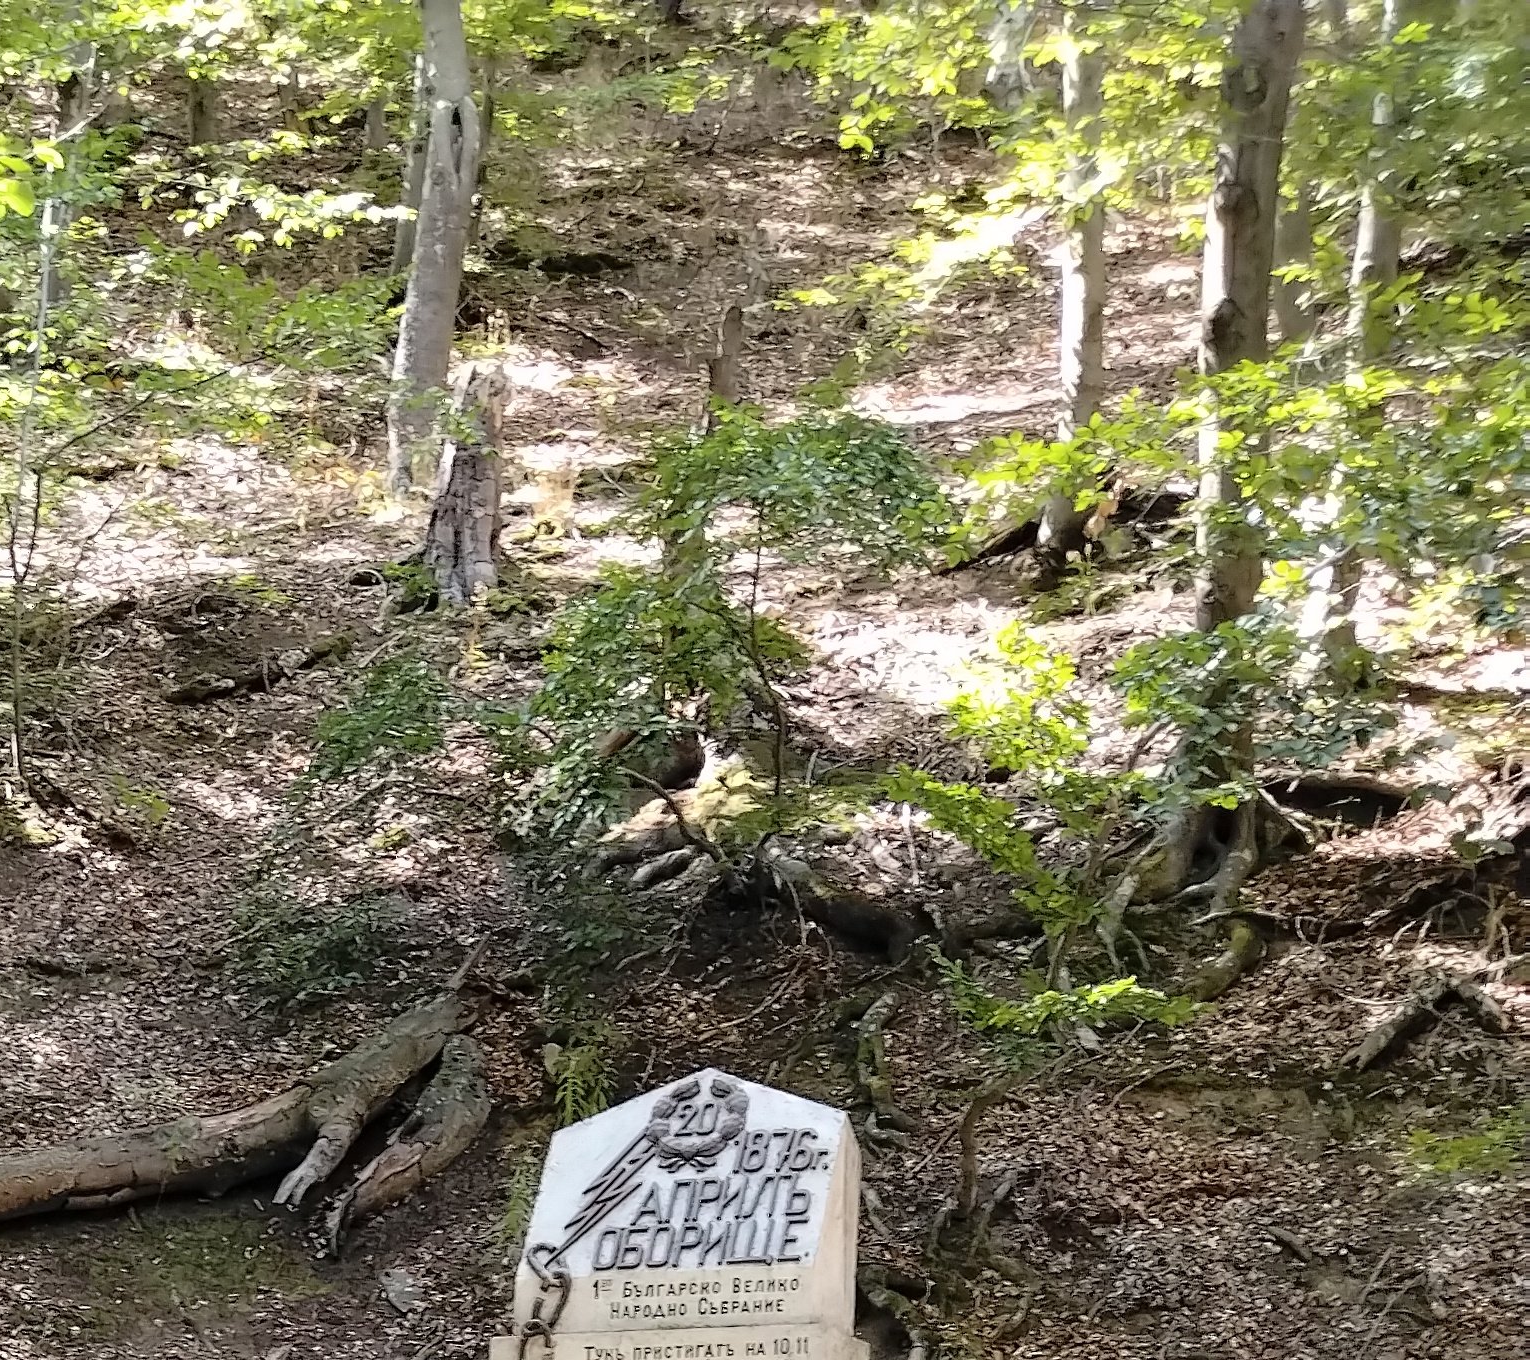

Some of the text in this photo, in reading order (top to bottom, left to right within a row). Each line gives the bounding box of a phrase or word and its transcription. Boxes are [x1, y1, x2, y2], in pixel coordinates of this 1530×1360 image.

[674, 1102, 721, 1138] 20
[732, 1277, 799, 1294] ВЕЛИКО
[610, 1301, 687, 1319] НАРОДНО
[745, 1342, 766, 1356] НА
